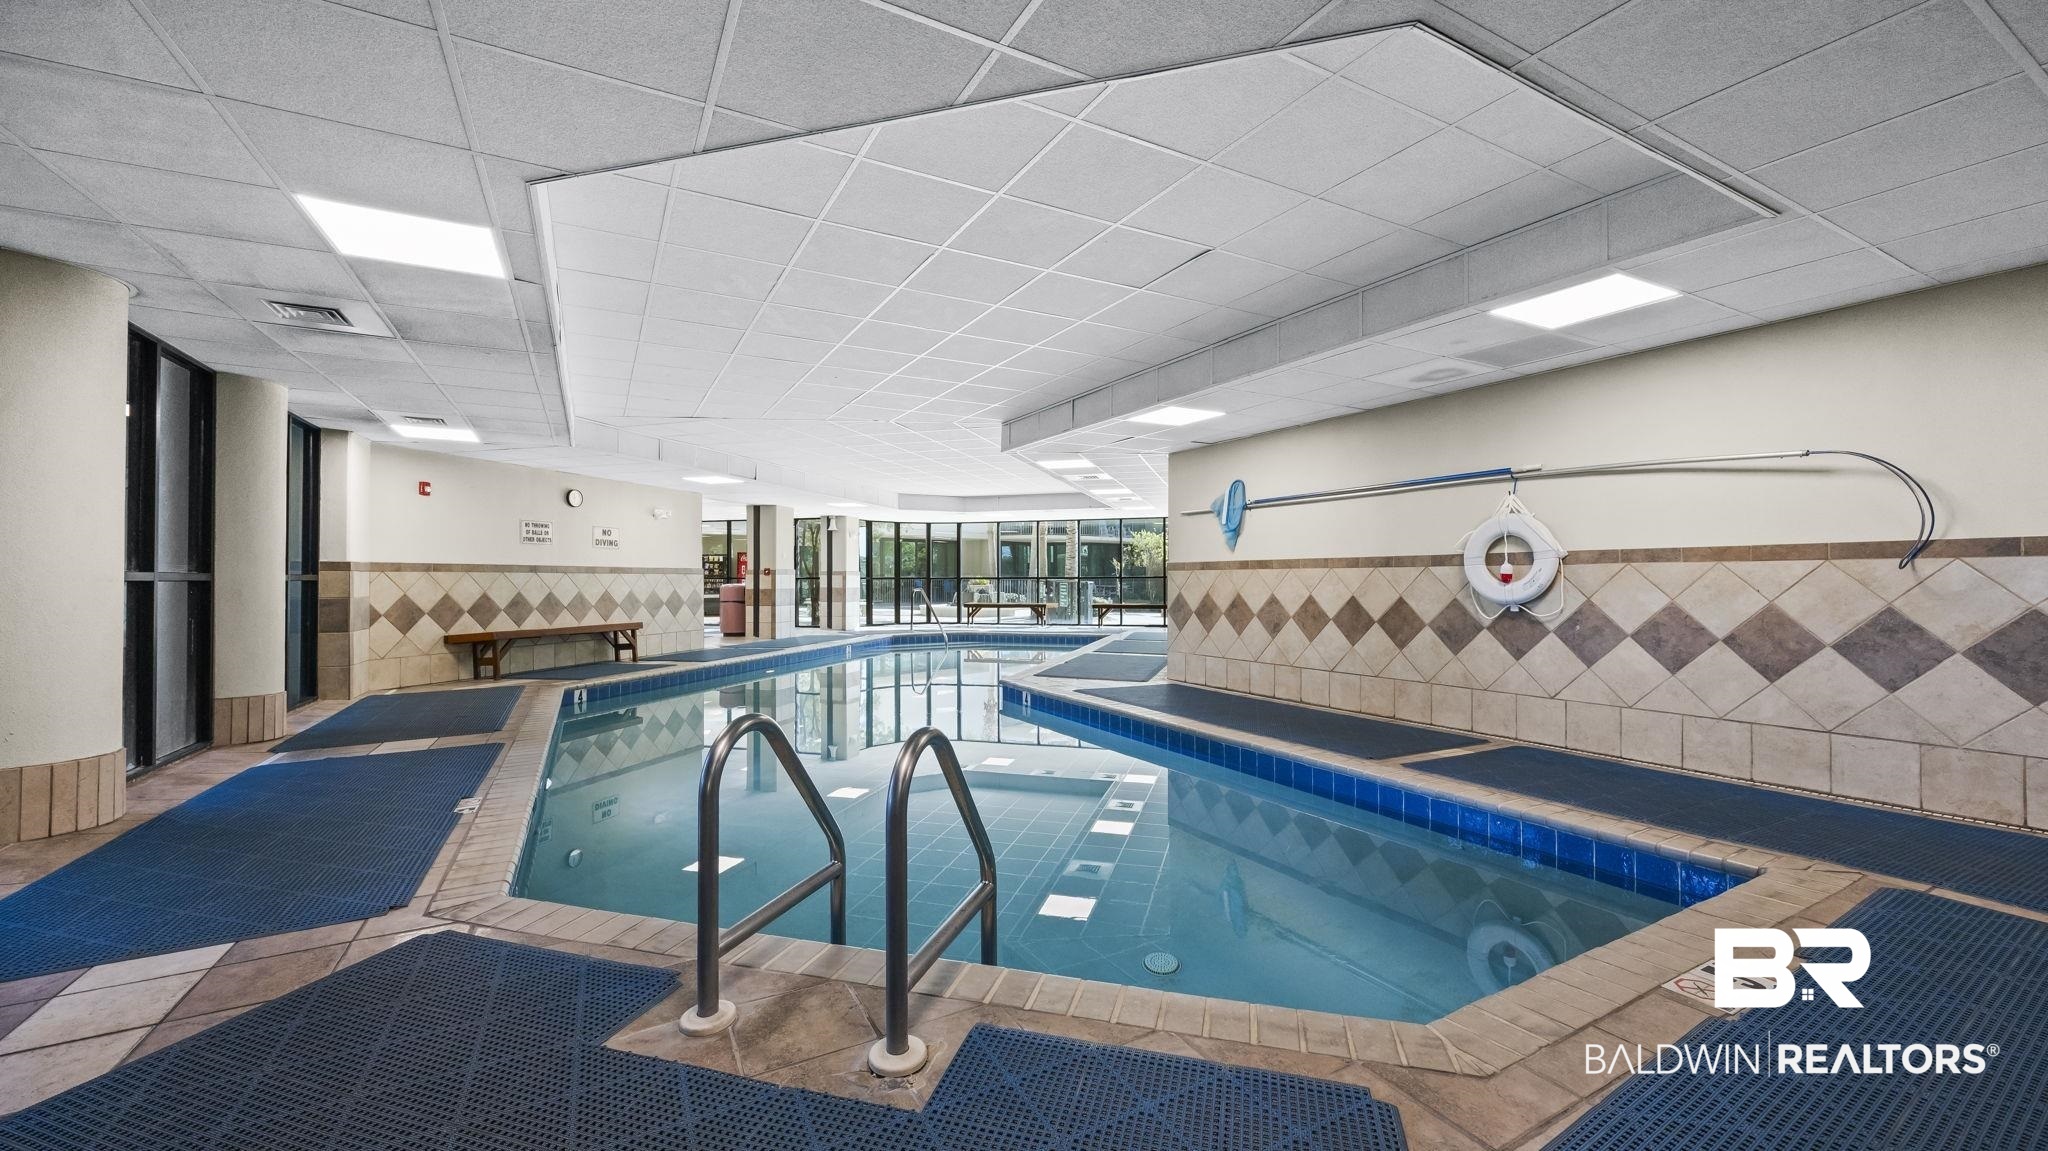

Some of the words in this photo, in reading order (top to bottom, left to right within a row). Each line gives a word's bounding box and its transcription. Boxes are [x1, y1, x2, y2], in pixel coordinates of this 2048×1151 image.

[602, 528, 612, 536] NO
[595, 538, 619, 547] DIVING
[578, 689, 584, 701] 4
